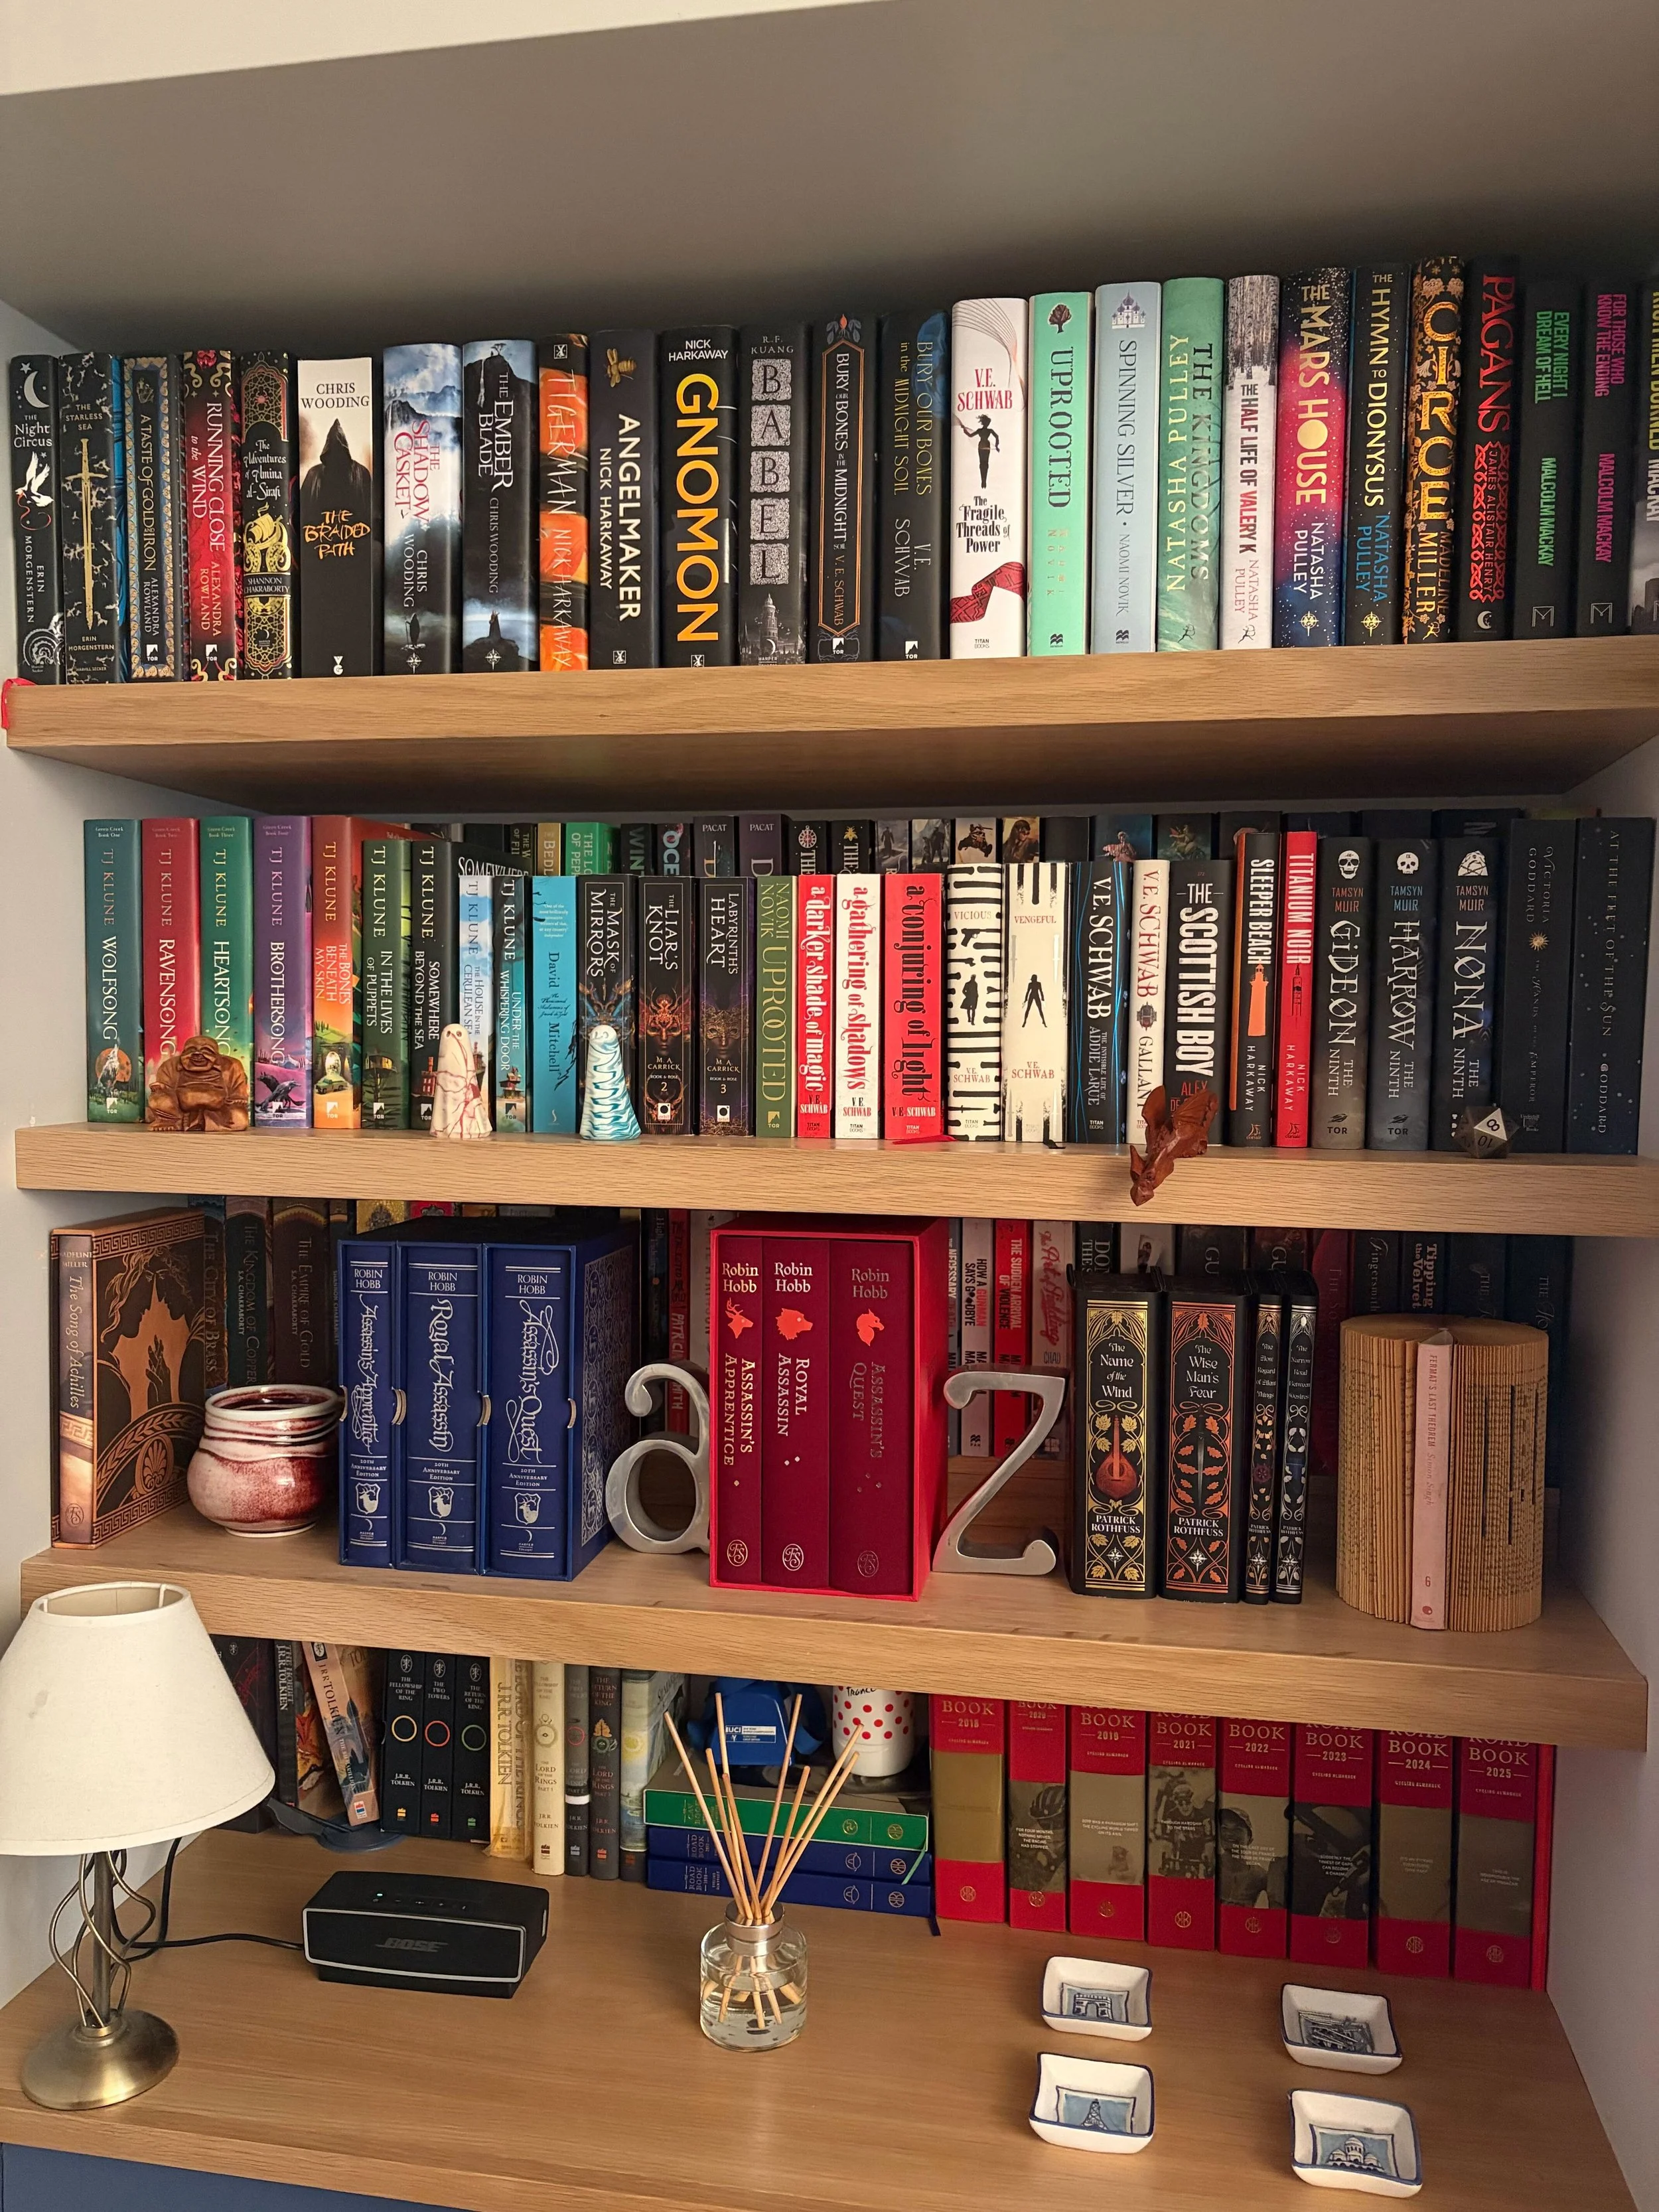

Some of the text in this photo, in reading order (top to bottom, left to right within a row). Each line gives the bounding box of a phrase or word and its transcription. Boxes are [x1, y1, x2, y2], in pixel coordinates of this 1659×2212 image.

[1373, 273, 1393, 283] THE
[668, 350, 728, 362] HARKAWAY
[685, 339, 711, 349] NICK
[751, 345, 794, 355] KUANG
[1477, 274, 1515, 433] PAGANS
[316, 382, 355, 395] CHRIS
[835, 353, 849, 392] BURY
[974, 368, 995, 388] V.E.
[301, 396, 370, 409] WOODING
[957, 391, 1013, 411] SCHWAB
[1296, 283, 1330, 506] THE MARS HOUSE
[1364, 288, 1390, 507] HYMN TO DIONYSUS
[1417, 301, 1458, 521] CIRCE
[15, 423, 50, 437] Night
[66, 412, 103, 421] STARLESS
[491, 372, 514, 492] THE EMBER
[835, 400, 849, 451] BONES
[1048, 346, 1073, 508] UPROOTED
[1116, 339, 1137, 516] SPINNING SILVER
[14, 436, 52, 449] Circus
[244, 452, 286, 467] Adventures
[255, 439, 270, 451] The
[430, 445, 439, 471] THE
[478, 413, 494, 477] BLADE
[546, 370, 577, 516] TIGERMAN
[207, 402, 225, 552] RUNNING CLOSE
[252, 469, 282, 482] Amina
[394, 431, 413, 510] CASKET
[412, 419, 430, 522] SHADOW
[1167, 334, 1189, 592] NATASHA PULLEY
[1191, 343, 1213, 580] THE KINGDOMS
[1239, 384, 1259, 553] THE HALF LIFE OF VALERY K
[192, 465, 207, 518] WIND
[246, 482, 281, 500] al-Sirafi
[676, 373, 719, 641] GNOMON
[833, 467, 847, 542] MIDNIGHT
[974, 496, 987, 506] The
[321, 509, 352, 523] THE
[618, 413, 641, 622] ANGELMAKER
[961, 504, 1006, 522] Fragile
[1538, 458, 1556, 566] MALCOLM MACKAY
[303, 522, 370, 543] BRAIDED
[956, 522, 1011, 540] Threads of
[966, 539, 1001, 553] Power
[318, 543, 355, 559] PATH
[838, 555, 844, 565] V.
[25, 536, 35, 624] MORGENSTERN
[835, 567, 845, 577] E.
[1417, 532, 1437, 613] MILLER
[834, 580, 844, 625] SCHWAB
[103, 849, 114, 926] TJ KLUNE
[1187, 883, 1213, 904] THE
[1332, 887, 1364, 898] TAMSYN
[1526, 848, 1536, 923] GODDARD
[954, 911, 991, 920] VICIOUS
[1014, 915, 1056, 924] VENGEFUL
[1248, 859, 1275, 965] SLEEPER BEACH
[1286, 853, 1314, 965] TITANIUM NOIR
[1334, 901, 1359, 913] MUIR
[590, 889, 607, 978] MIRRORS
[665, 910, 678, 970] LIAR'S
[711, 897, 725, 968] HEART
[728, 893, 738, 974] LABYRINTH'S
[842, 899, 875, 990] gathering
[102, 936, 118, 1041] WOLFSONG
[326, 946, 336, 1001] BENEATH
[549, 952, 560, 988] David
[159, 939, 176, 1056] RAVENSONG
[270, 941, 285, 1064] BROTHERSONG
[429, 961, 440, 1040] SOMEWHERE
[800, 899, 831, 1092] darker shade of magic
[1175, 907, 1219, 1077] SCOTTISH BOY
[762, 946, 787, 1102] UPROOTED
[841, 994, 873, 1090] of shadows
[549, 1022, 561, 1072] Mitchell
[1388, 1051, 1400, 1099] NINTH
[843, 1107, 871, 1116] SCHWAB
[518, 1274, 547, 1285] ROBIN
[774, 1262, 813, 1277] Robin
[775, 1278, 811, 1293] Hobb
[519, 1284, 546, 1295] HOBB
[1100, 1354, 1133, 1368] Name
[1189, 1355, 1218, 1369] Wise
[70, 1357, 84, 1408] Achilles
[795, 1357, 810, 1415] ROYAL
[1102, 1385, 1132, 1398] Wind
[1189, 1385, 1216, 1399] Fear
[723, 1353, 738, 1466] APPRENTICE
[741, 1359, 755, 1453] ASSASSIN'S
[1091, 1524, 1141, 1534] ROTHFUSS
[1096, 1515, 1136, 1526] PATRICK
[1156, 1722, 1212, 1736] BOOK
[1173, 1739, 1195, 1749] 2021
[1323, 1751, 1346, 1761] 2023
[1388, 1741, 1449, 1757] BOOK
[1406, 1759, 1431, 1770] 2024
[1486, 1767, 1512, 1779] 2025
[376, 1938, 449, 1953] BOSE
